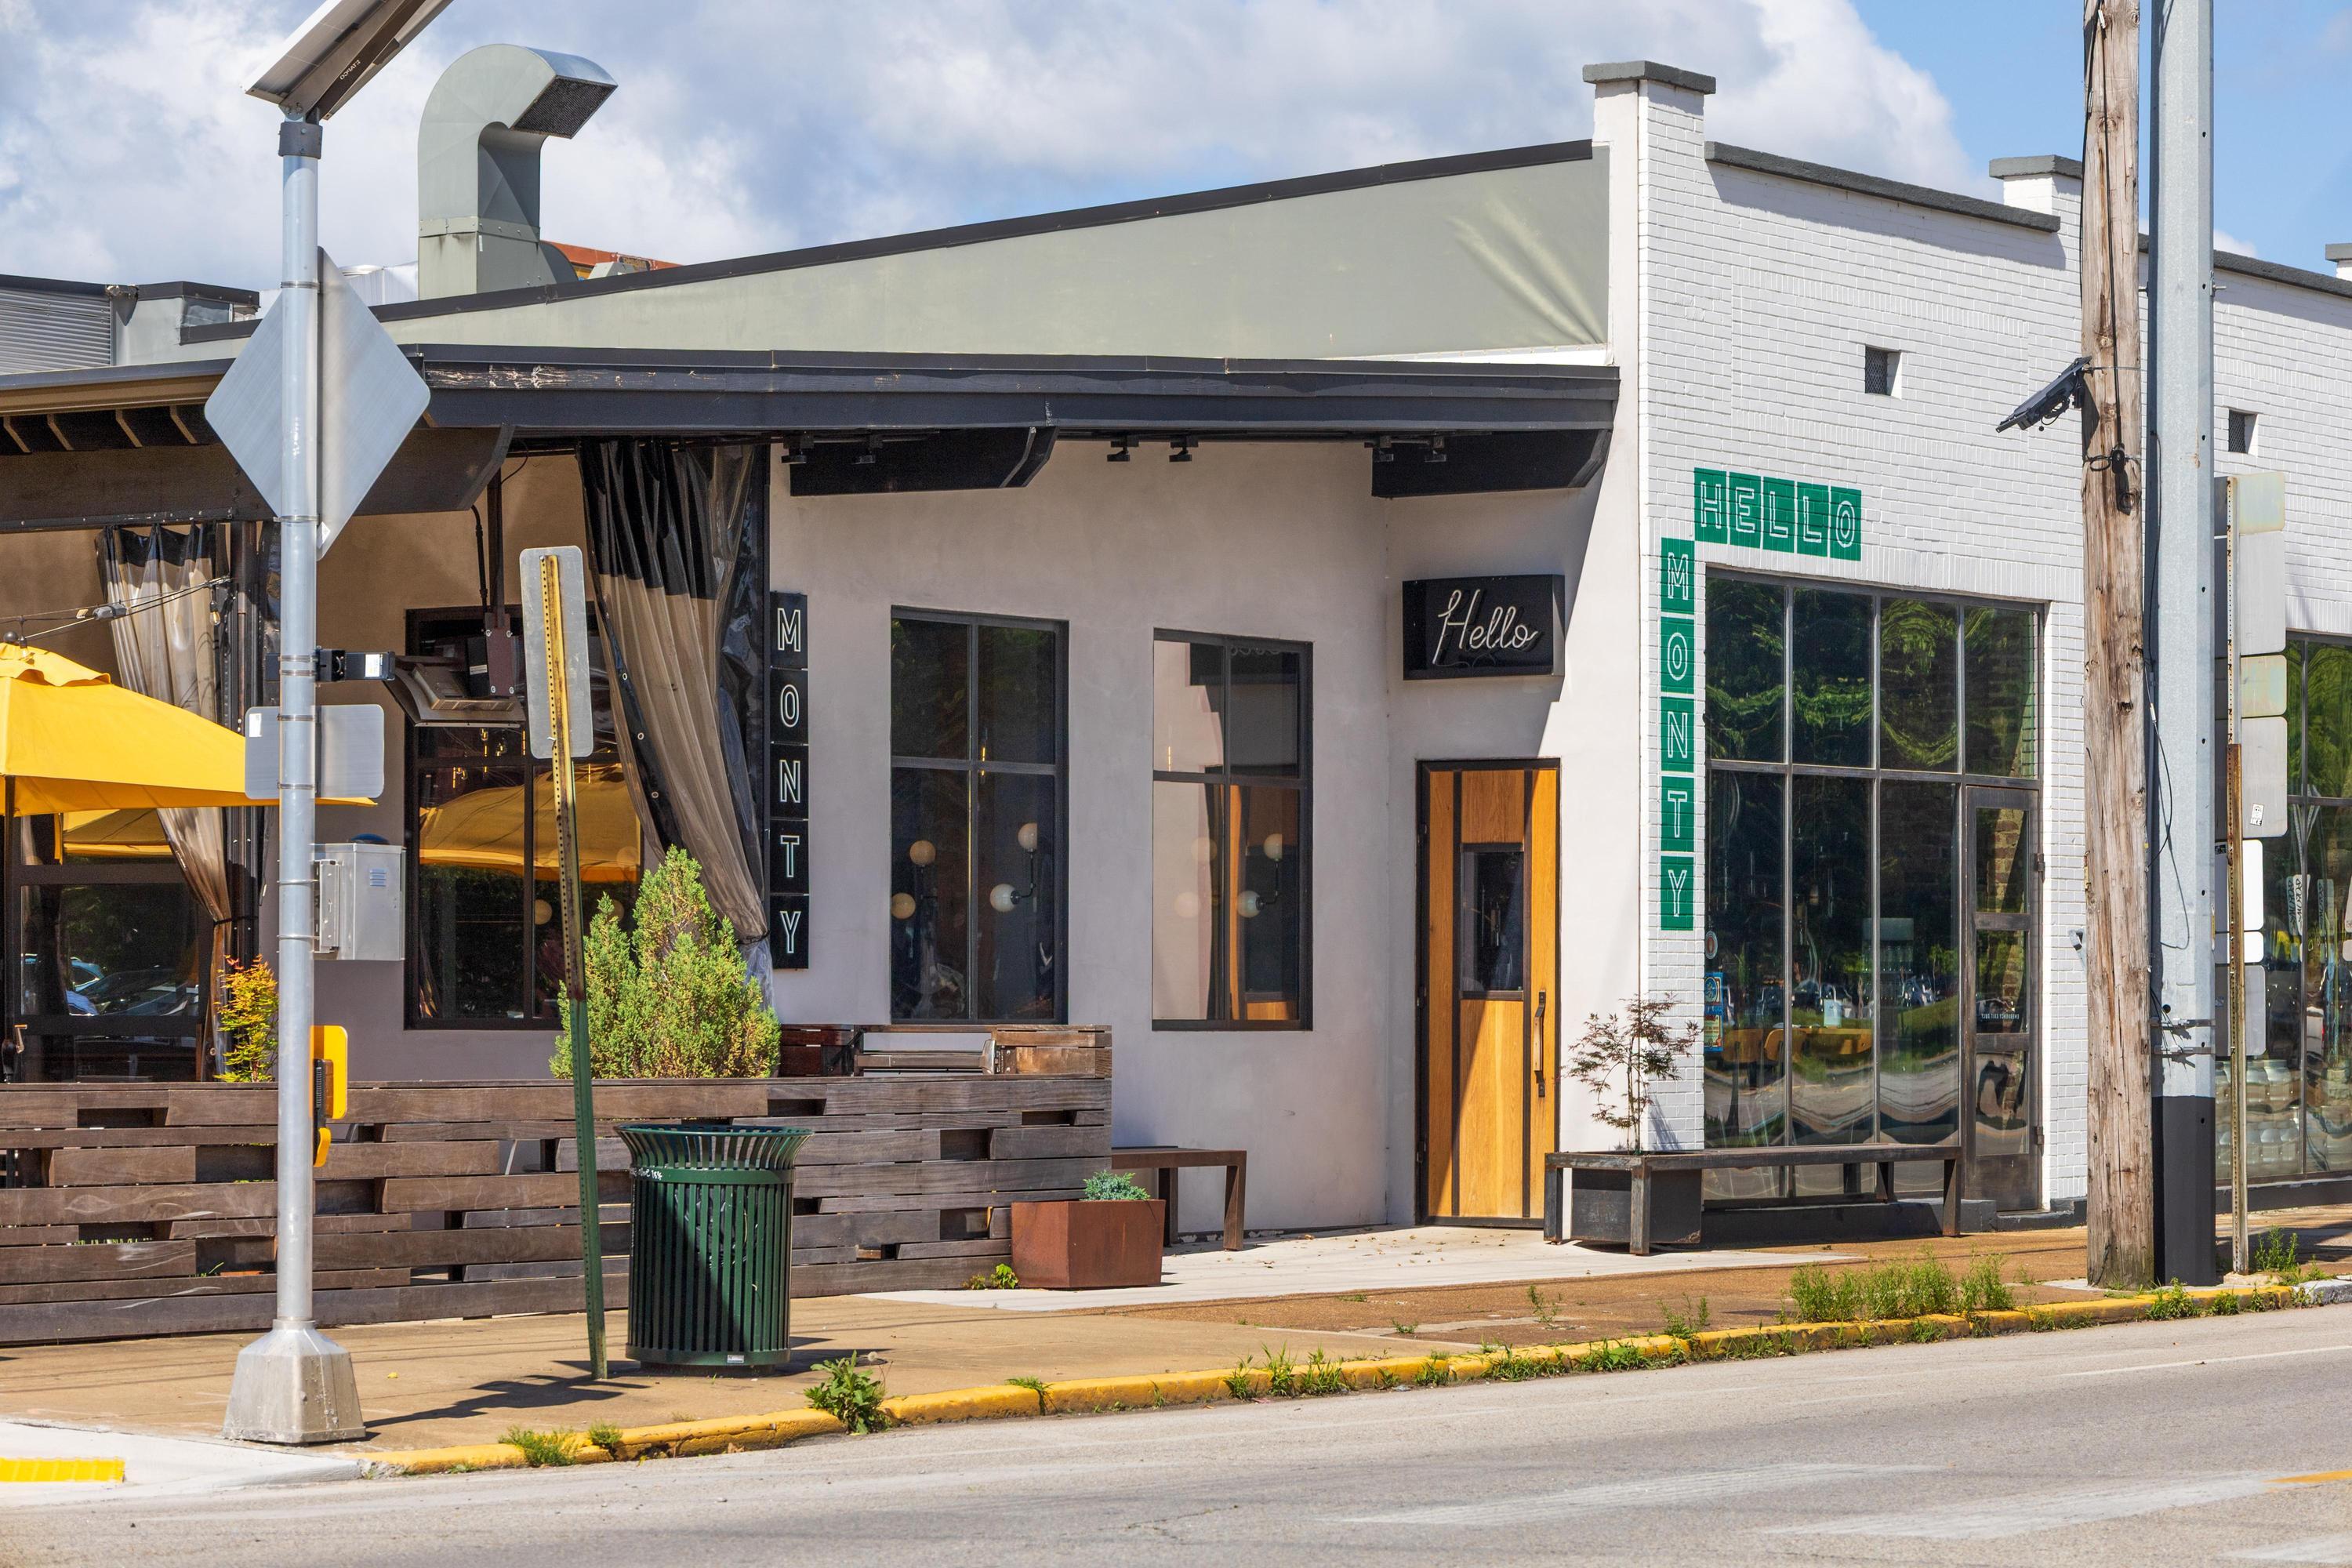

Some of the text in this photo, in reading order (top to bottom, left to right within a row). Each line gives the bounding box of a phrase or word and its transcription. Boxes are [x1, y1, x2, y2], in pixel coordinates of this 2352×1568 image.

[1700, 481, 1856, 548] HELLO
[1432, 589, 1539, 665] Hello
[777, 608, 801, 954] MONTY
[1667, 551, 1689, 917] MONTY
